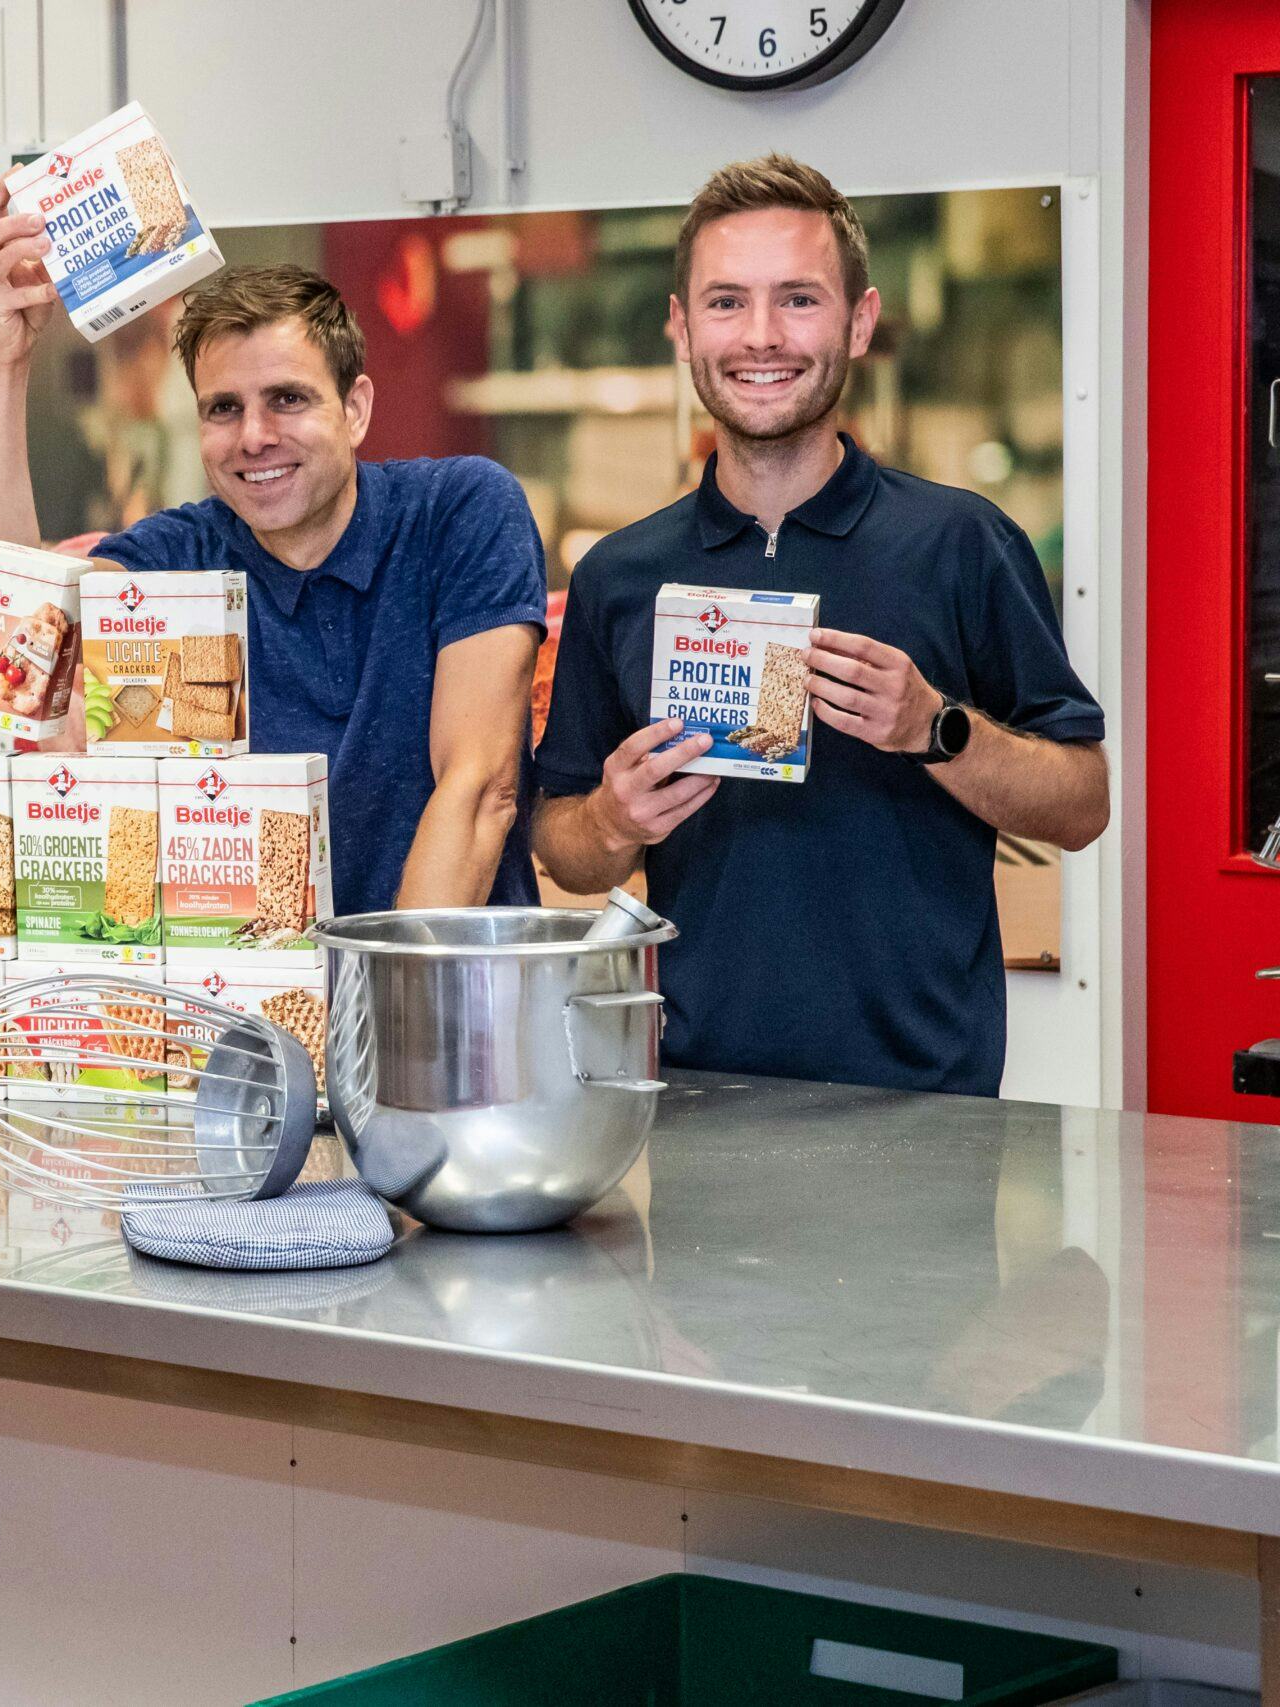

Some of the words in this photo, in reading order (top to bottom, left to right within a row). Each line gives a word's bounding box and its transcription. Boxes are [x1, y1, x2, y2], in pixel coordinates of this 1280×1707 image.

[710, 16, 727, 45] 7
[810, 8, 828, 37] 5
[758, 28, 777, 57] 6
[38, 166, 105, 214] Bolletje
[46, 184, 122, 242] PROTEIN
[57, 243, 69, 258] &
[70, 226, 95, 252] LOW
[96, 206, 129, 234] CARB
[64, 223, 137, 275] CRACKERS
[100, 616, 166, 636] Bolletje
[106, 642, 161, 662] LICHTE
[675, 636, 750, 658] Bolletje
[113, 665, 156, 674] CRACKERS
[669, 659, 751, 688] PROTEIN
[668, 686, 680, 698] &
[684, 687, 711, 702] LOW
[714, 689, 750, 706] CARB
[667, 704, 749, 726] CRACKERS
[28, 803, 100, 824] Bolletje
[176, 806, 251, 828] Bolletje
[19, 834, 42, 856] 50%
[44, 835, 103, 858] GROENTE
[167, 836, 199, 860] 45%
[202, 837, 253, 861] ZADEN
[20, 860, 103, 882] CRACKERS
[168, 864, 254, 886] CRACKERS
[25, 915, 61, 930] SPINAZIE
